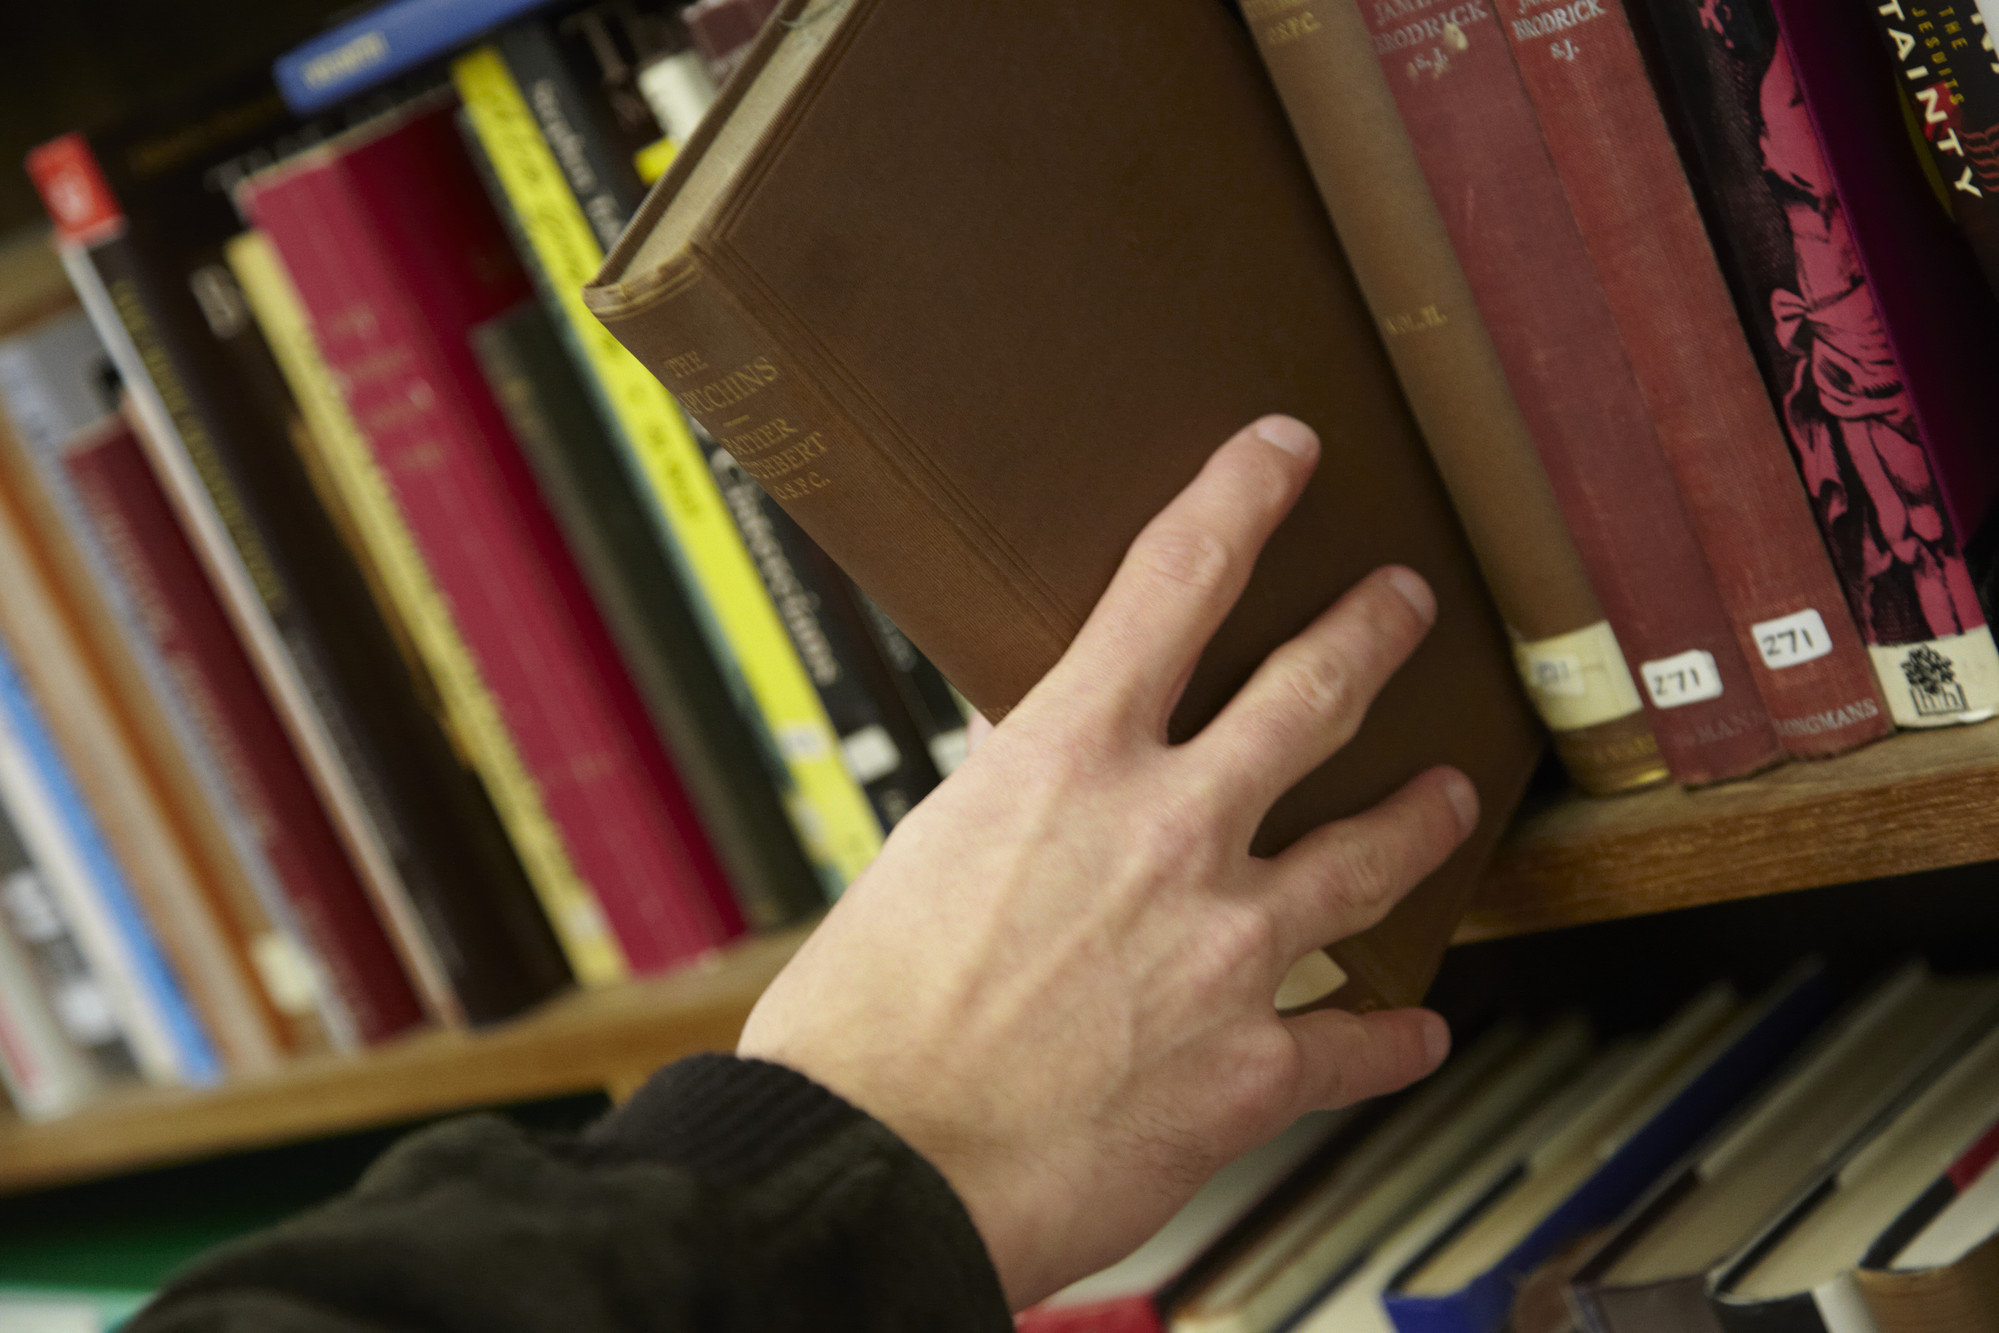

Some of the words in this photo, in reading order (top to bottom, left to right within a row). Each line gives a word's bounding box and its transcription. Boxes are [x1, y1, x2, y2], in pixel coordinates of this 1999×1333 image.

[1512, 0, 1606, 40] BRODRICK
[1938, 5, 1968, 50] THE
[1911, 7, 1965, 105] JESUITS
[664, 351, 708, 378] THE
[1763, 629, 1814, 656] 271
[1654, 667, 1700, 695] 271
